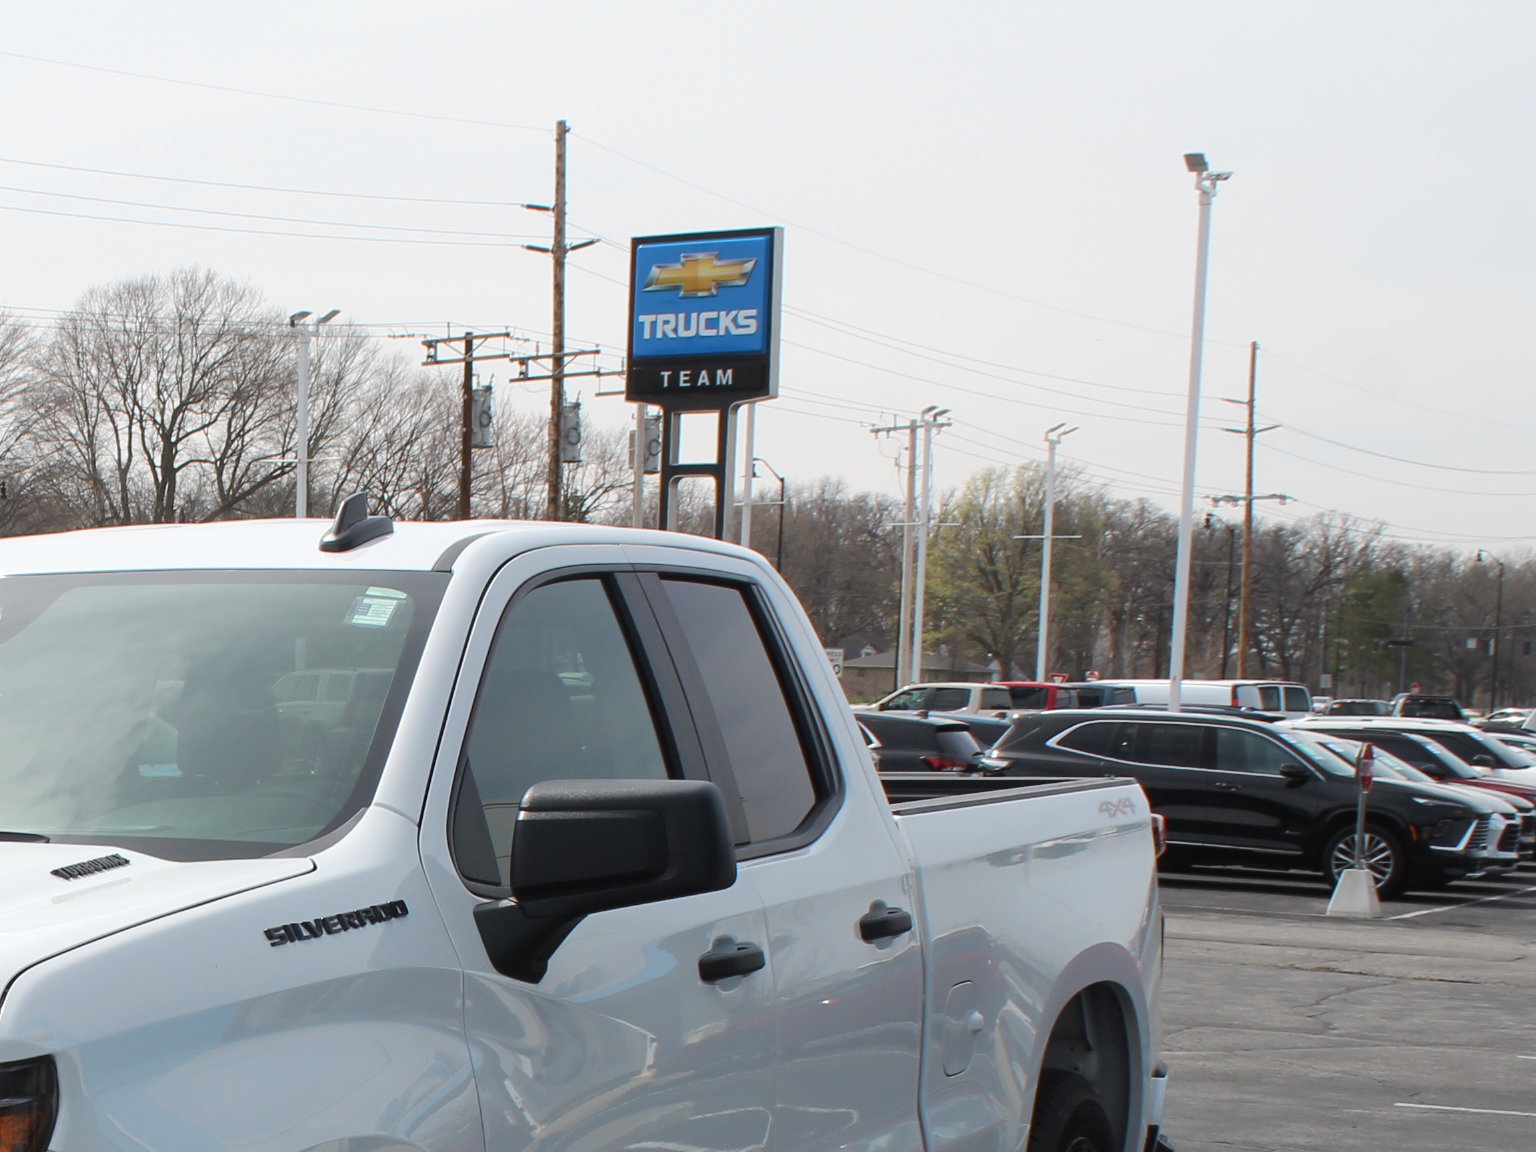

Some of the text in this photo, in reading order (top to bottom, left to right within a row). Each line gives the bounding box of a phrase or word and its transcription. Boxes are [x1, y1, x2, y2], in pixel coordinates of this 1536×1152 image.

[638, 309, 758, 340] TRUCKS
[661, 368, 733, 387] TEAM
[263, 900, 409, 947] SILVERADO
